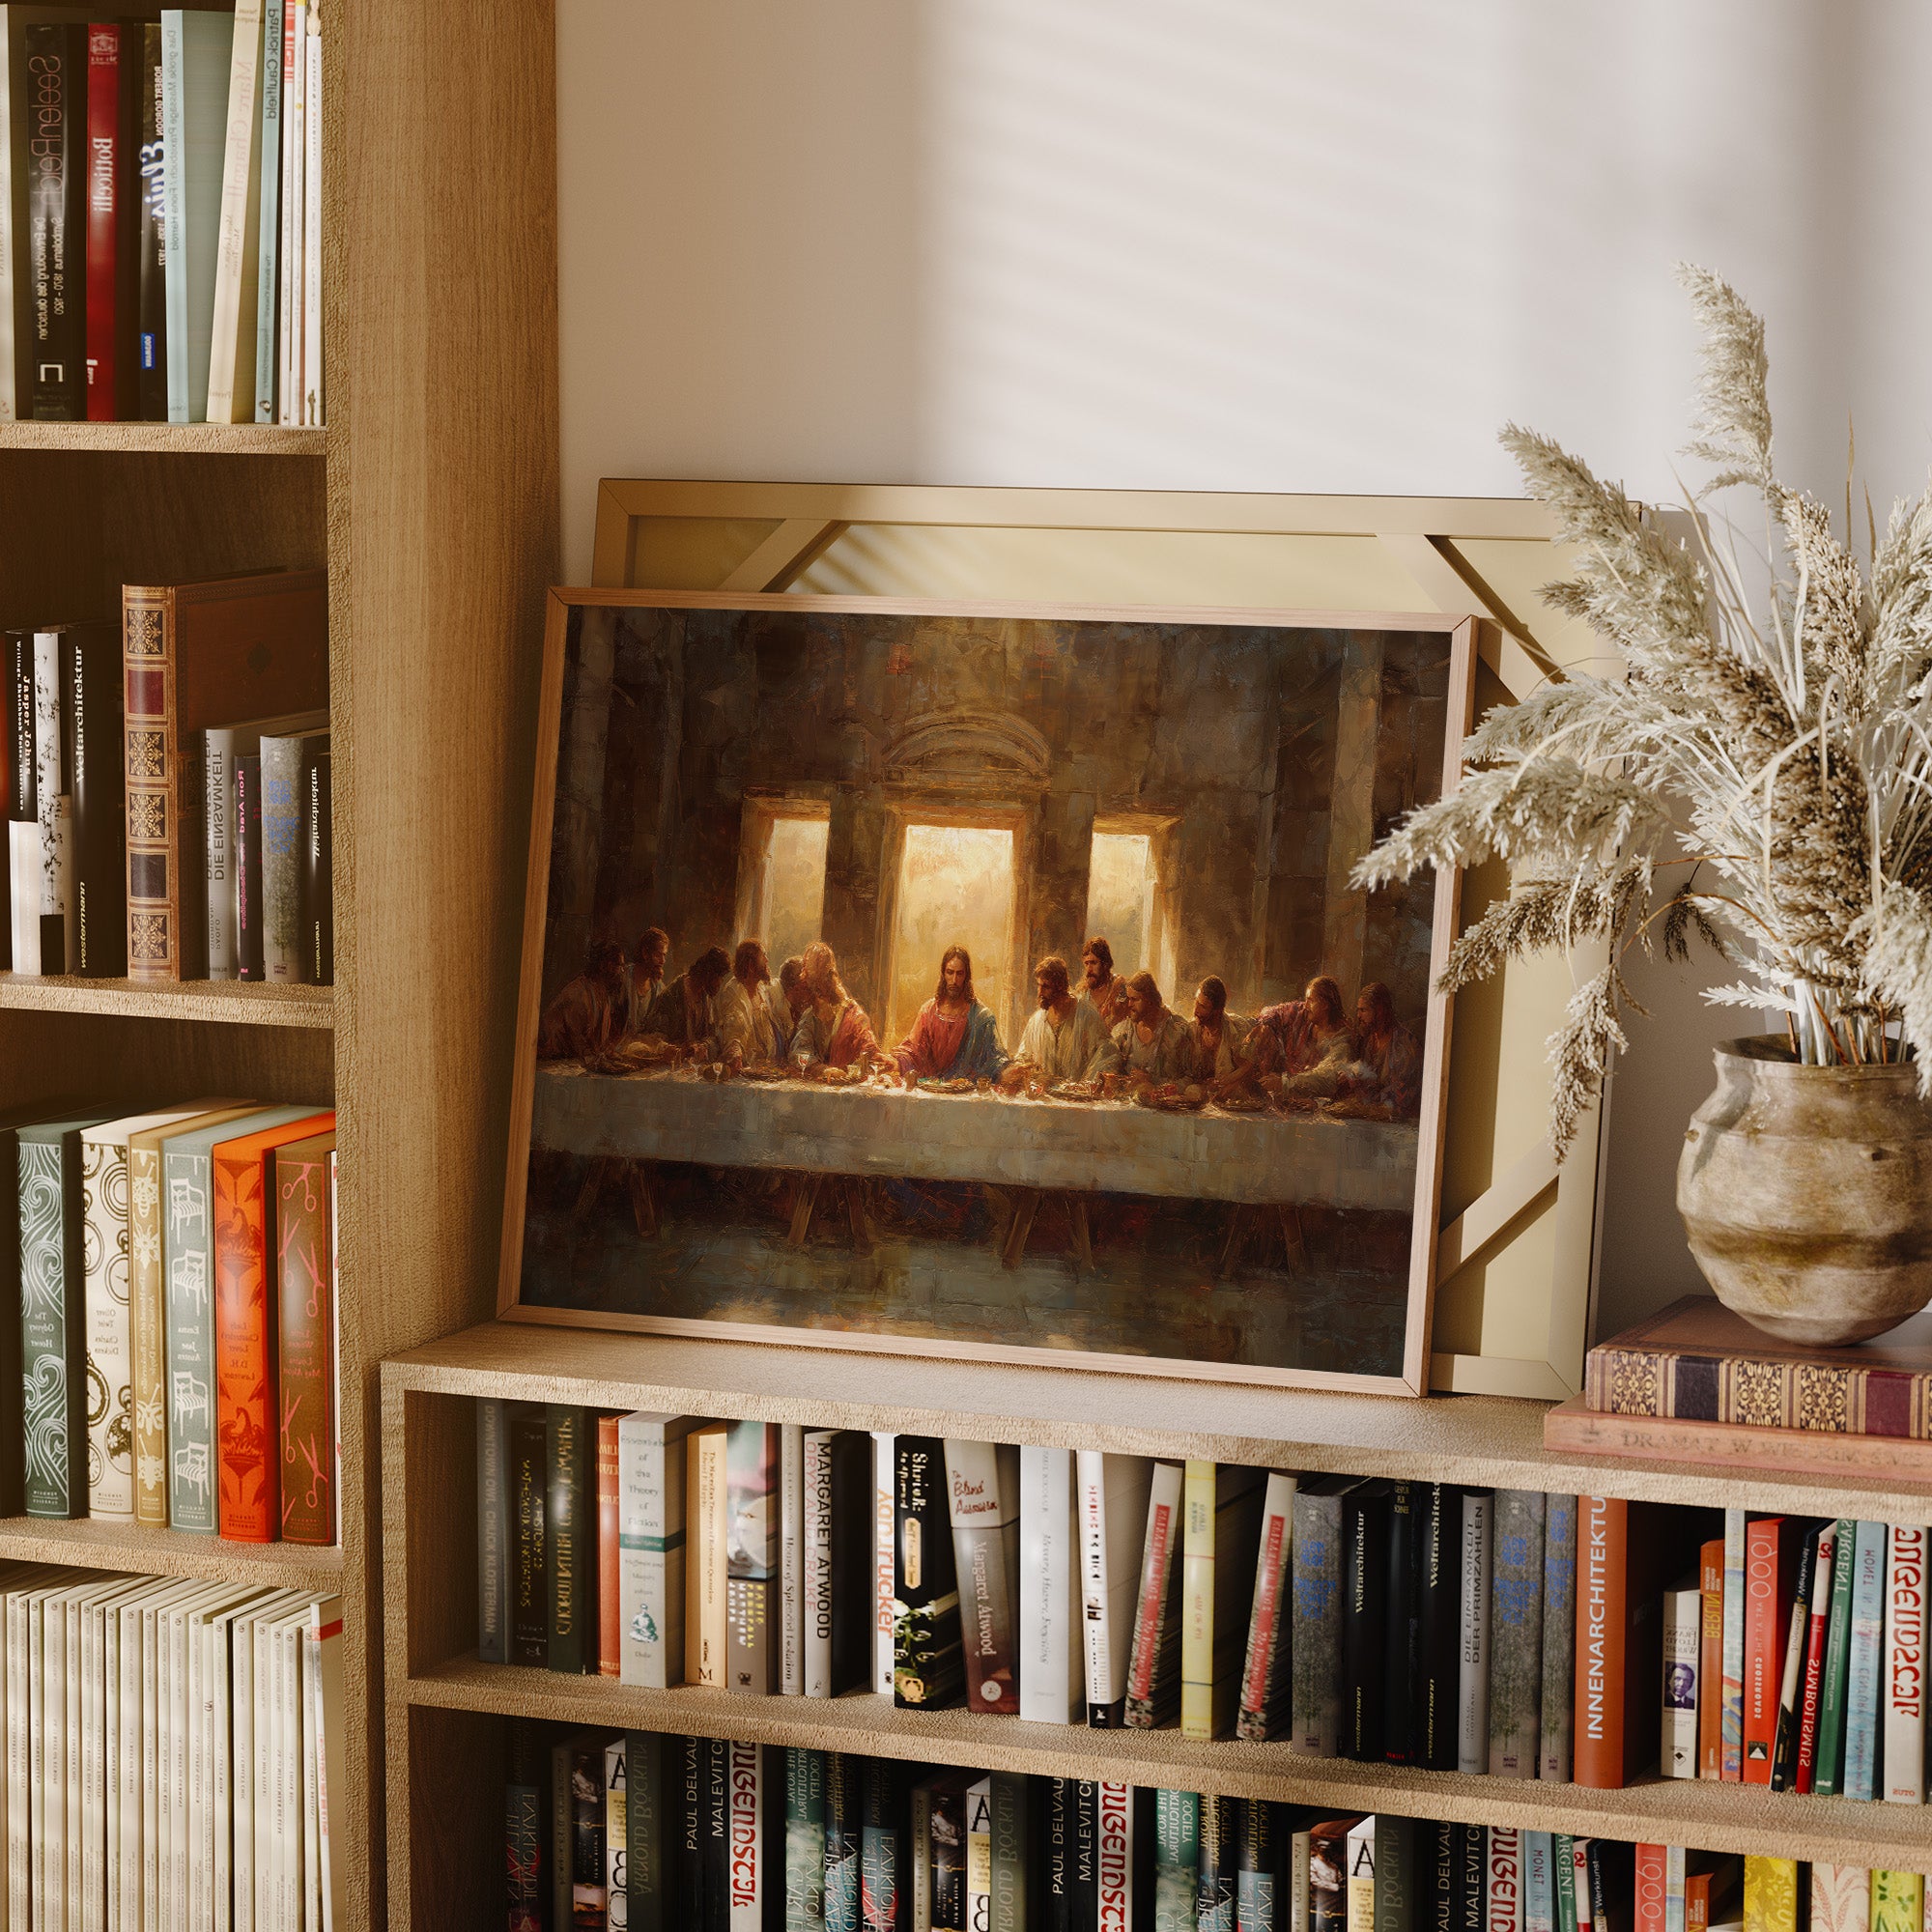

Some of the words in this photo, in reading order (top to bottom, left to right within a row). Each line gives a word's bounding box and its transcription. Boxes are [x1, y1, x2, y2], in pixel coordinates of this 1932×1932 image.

[74, 646, 85, 783] Weltarchitektur
[485, 1405, 496, 1476] DOWNTOWN
[806, 1441, 817, 1492] ORYX
[486, 1478, 496, 1504] OWL
[806, 1498, 816, 1539] AND
[817, 1442, 831, 1551] MARGARET
[953, 1481, 984, 1497] Blind
[486, 1511, 497, 1550] CHUCK
[806, 1547, 816, 1612] CRAKE
[972, 1541, 989, 1601] Margaret
[1355, 1512, 1365, 1614] Weltarchitektur
[1464, 1521, 1474, 1629] EINSAMKEIT
[1472, 1506, 1483, 1623] PRIMZAHLEN
[485, 1554, 497, 1634] KLOSTERMAN
[817, 1557, 831, 1639] ATWOOD
[978, 1605, 997, 1656] Atwood
[1472, 1628, 1481, 1664] DER
[1427, 1679, 1435, 1760] westermann
[686, 1807, 697, 1851] PAUL
[1052, 1851, 1064, 1894] PAUL
[1533, 1850, 1544, 1886] MONET
[1592, 1861, 1604, 1907] Werkkunst
[1636, 1856, 1662, 1918] 1900
